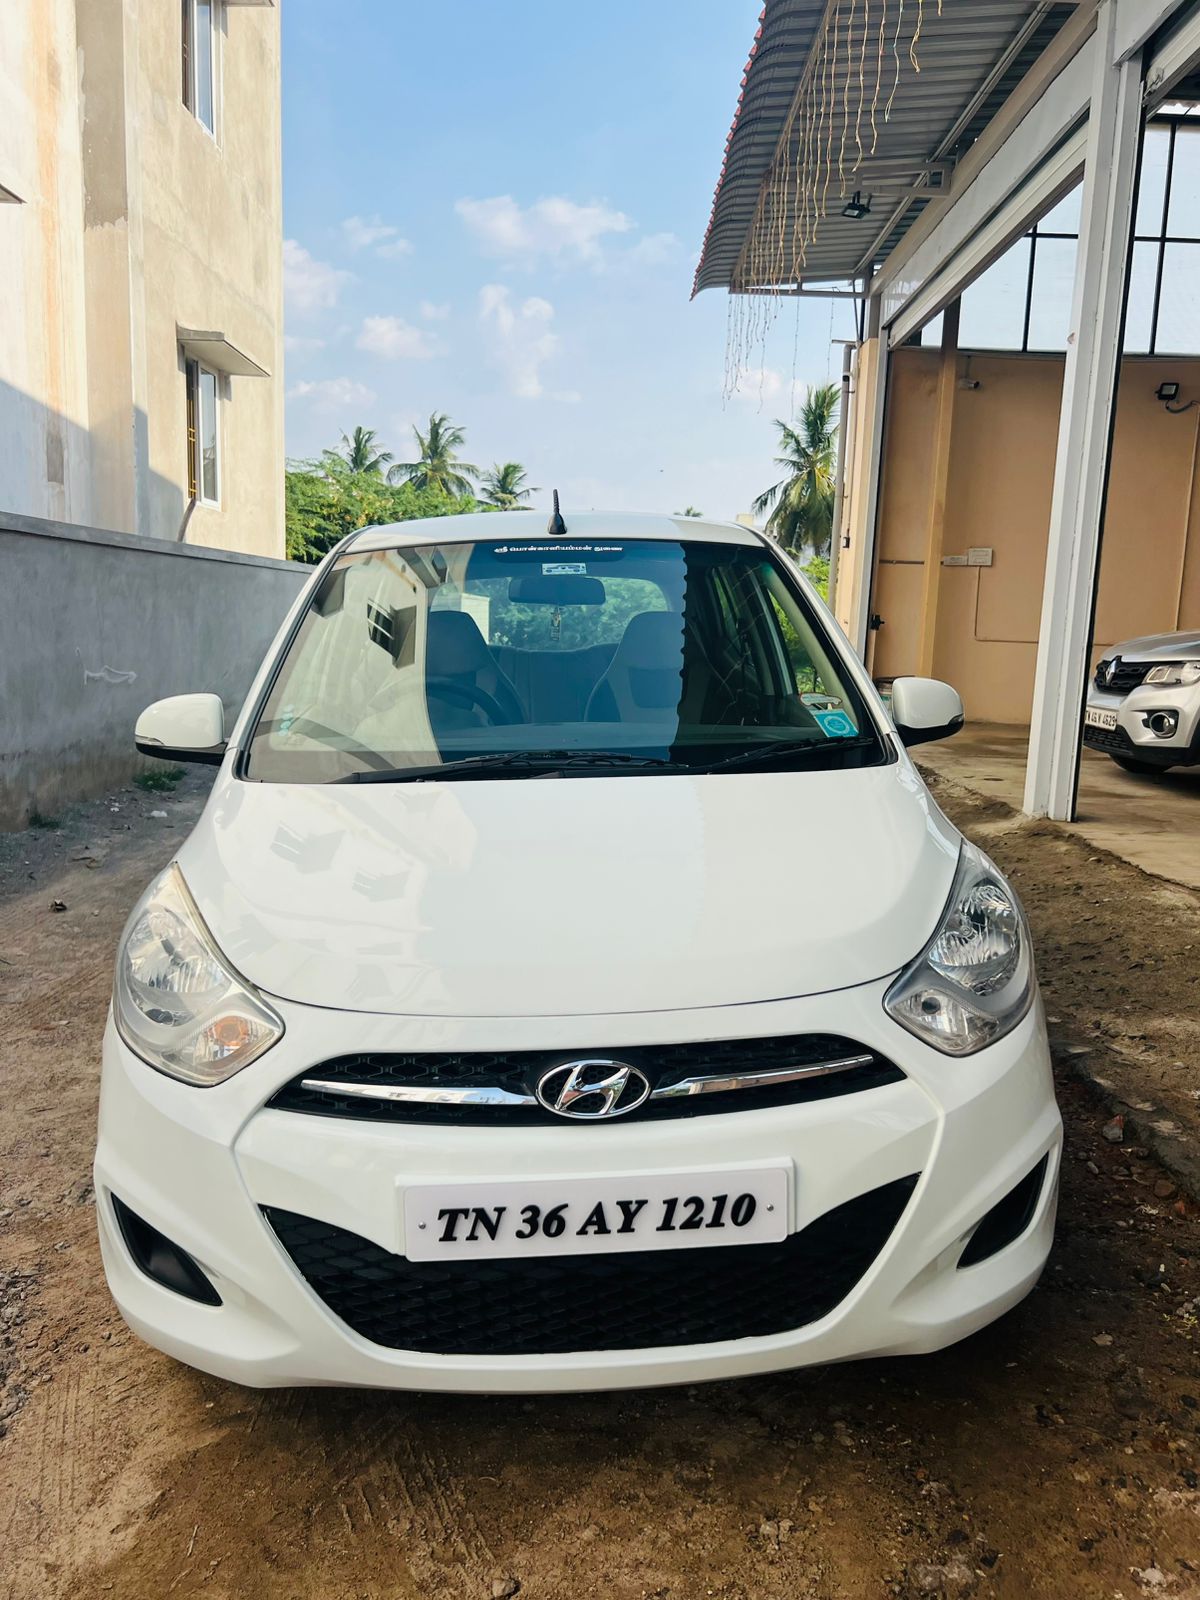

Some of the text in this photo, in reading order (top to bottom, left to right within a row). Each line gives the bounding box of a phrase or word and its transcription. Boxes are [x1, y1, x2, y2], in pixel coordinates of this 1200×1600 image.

[437, 1192, 757, 1242] TN 36 AY 1210
